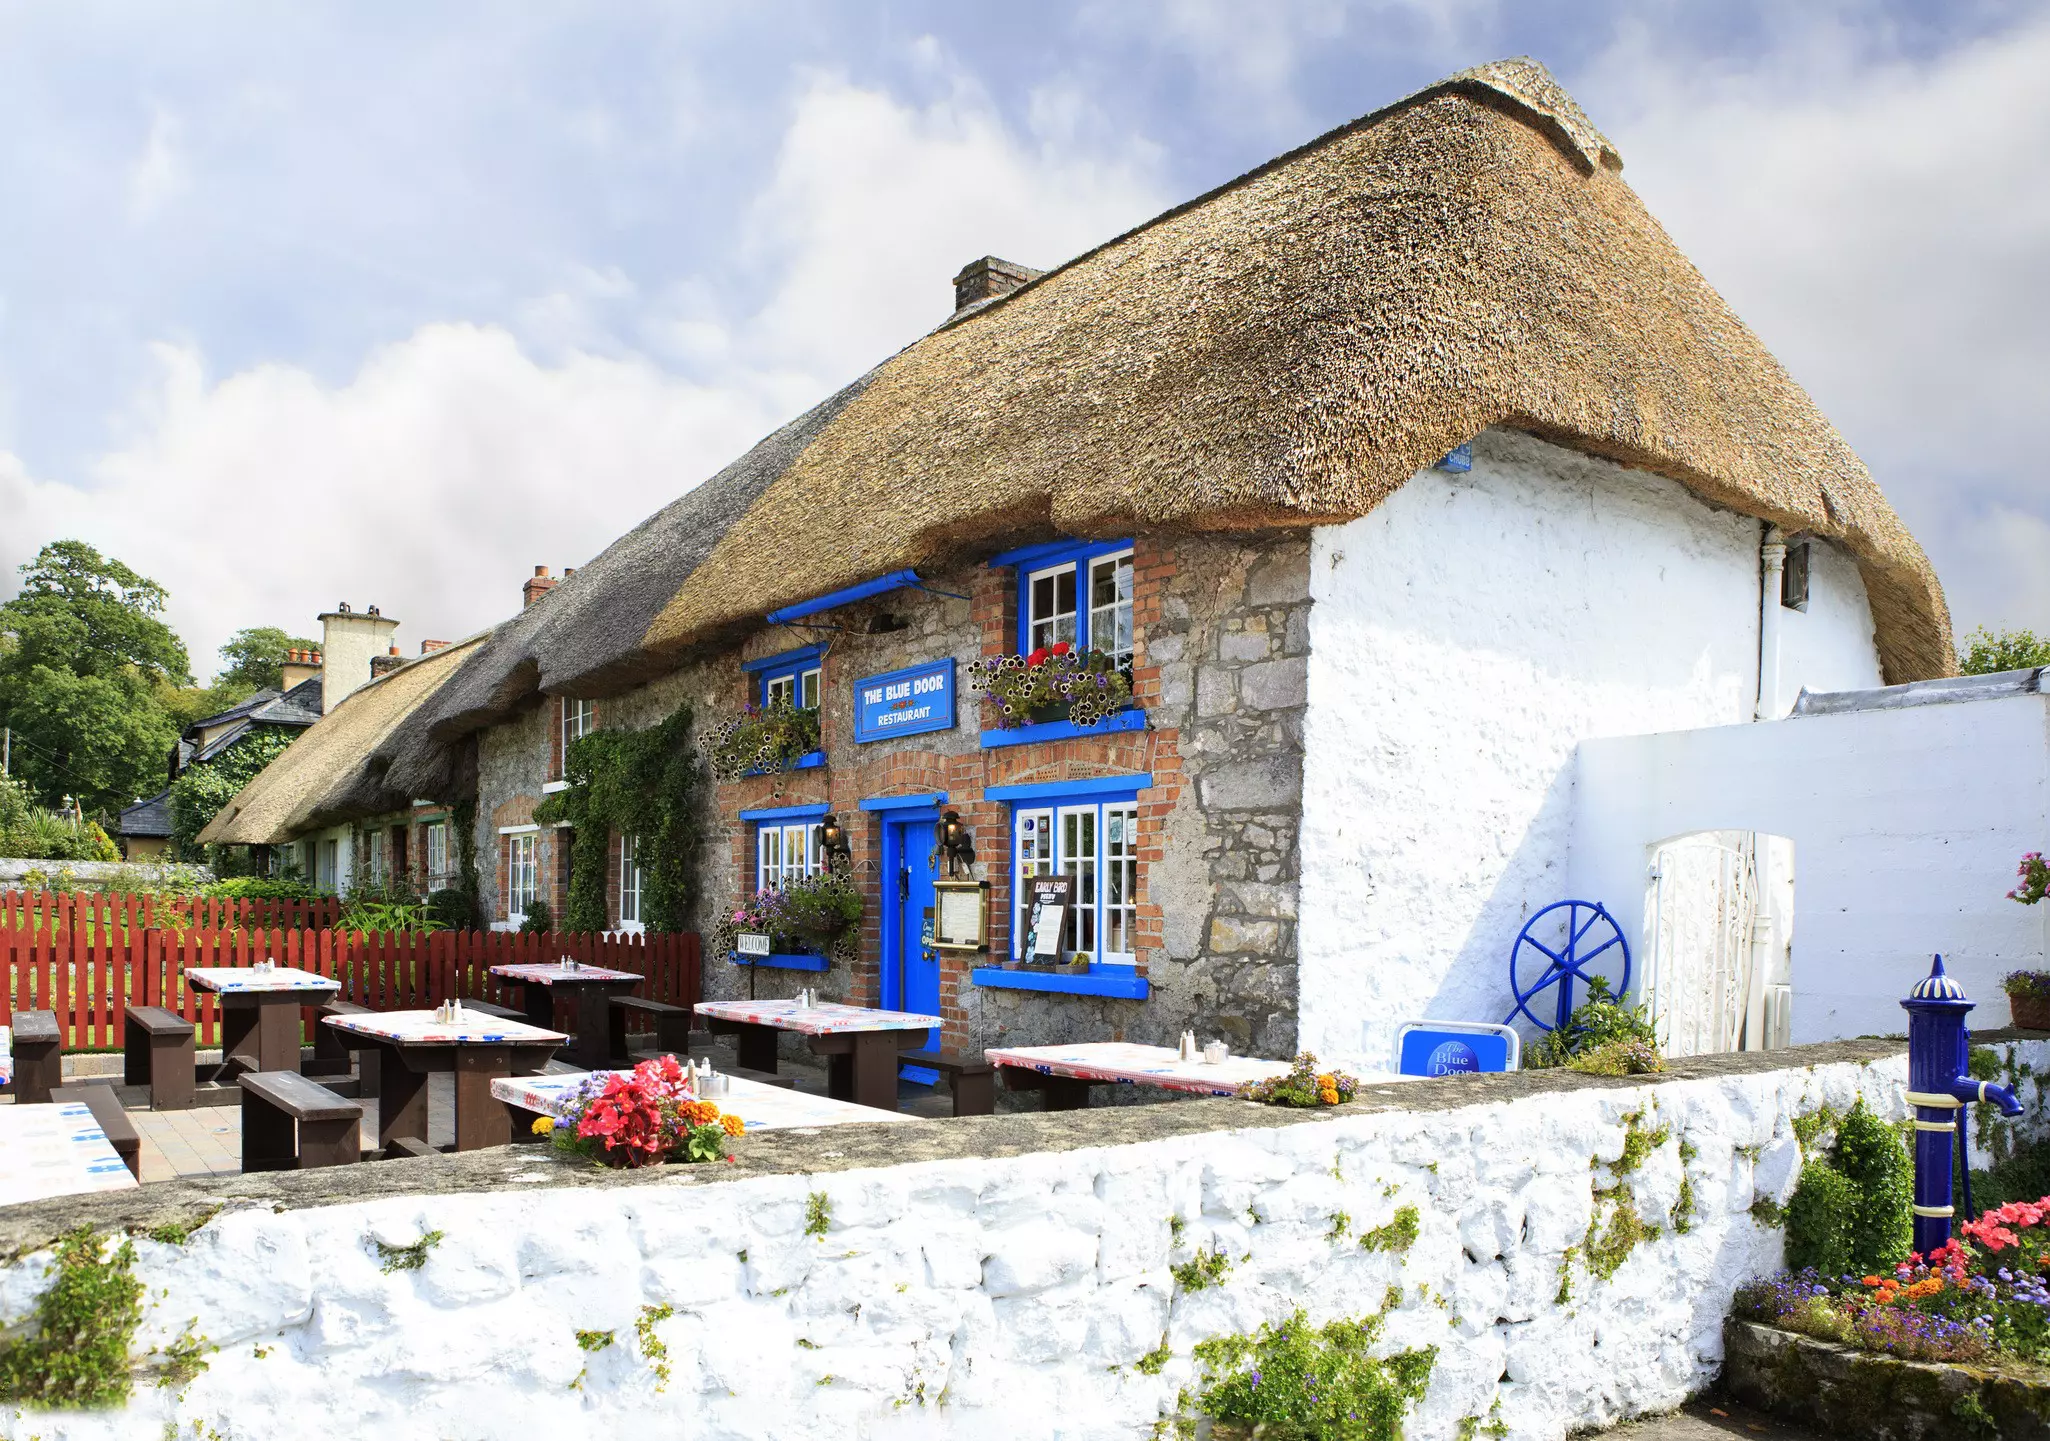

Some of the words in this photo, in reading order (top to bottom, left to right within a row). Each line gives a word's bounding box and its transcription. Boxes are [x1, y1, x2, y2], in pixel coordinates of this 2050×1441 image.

[1449, 452, 1470, 467] CHUBB
[864, 688, 883, 705] THE
[886, 682, 910, 700] BLUE
[914, 675, 944, 695] DOOR
[878, 706, 931, 726] RESTAURANT
[1035, 881, 1053, 893] EARLY
[1053, 882, 1068, 893] BIRD
[739, 936, 769, 953] WELCOME
[921, 935, 934, 946] OPE
[1446, 1043, 1464, 1053] The
[1435, 1052, 1468, 1065] Blue
